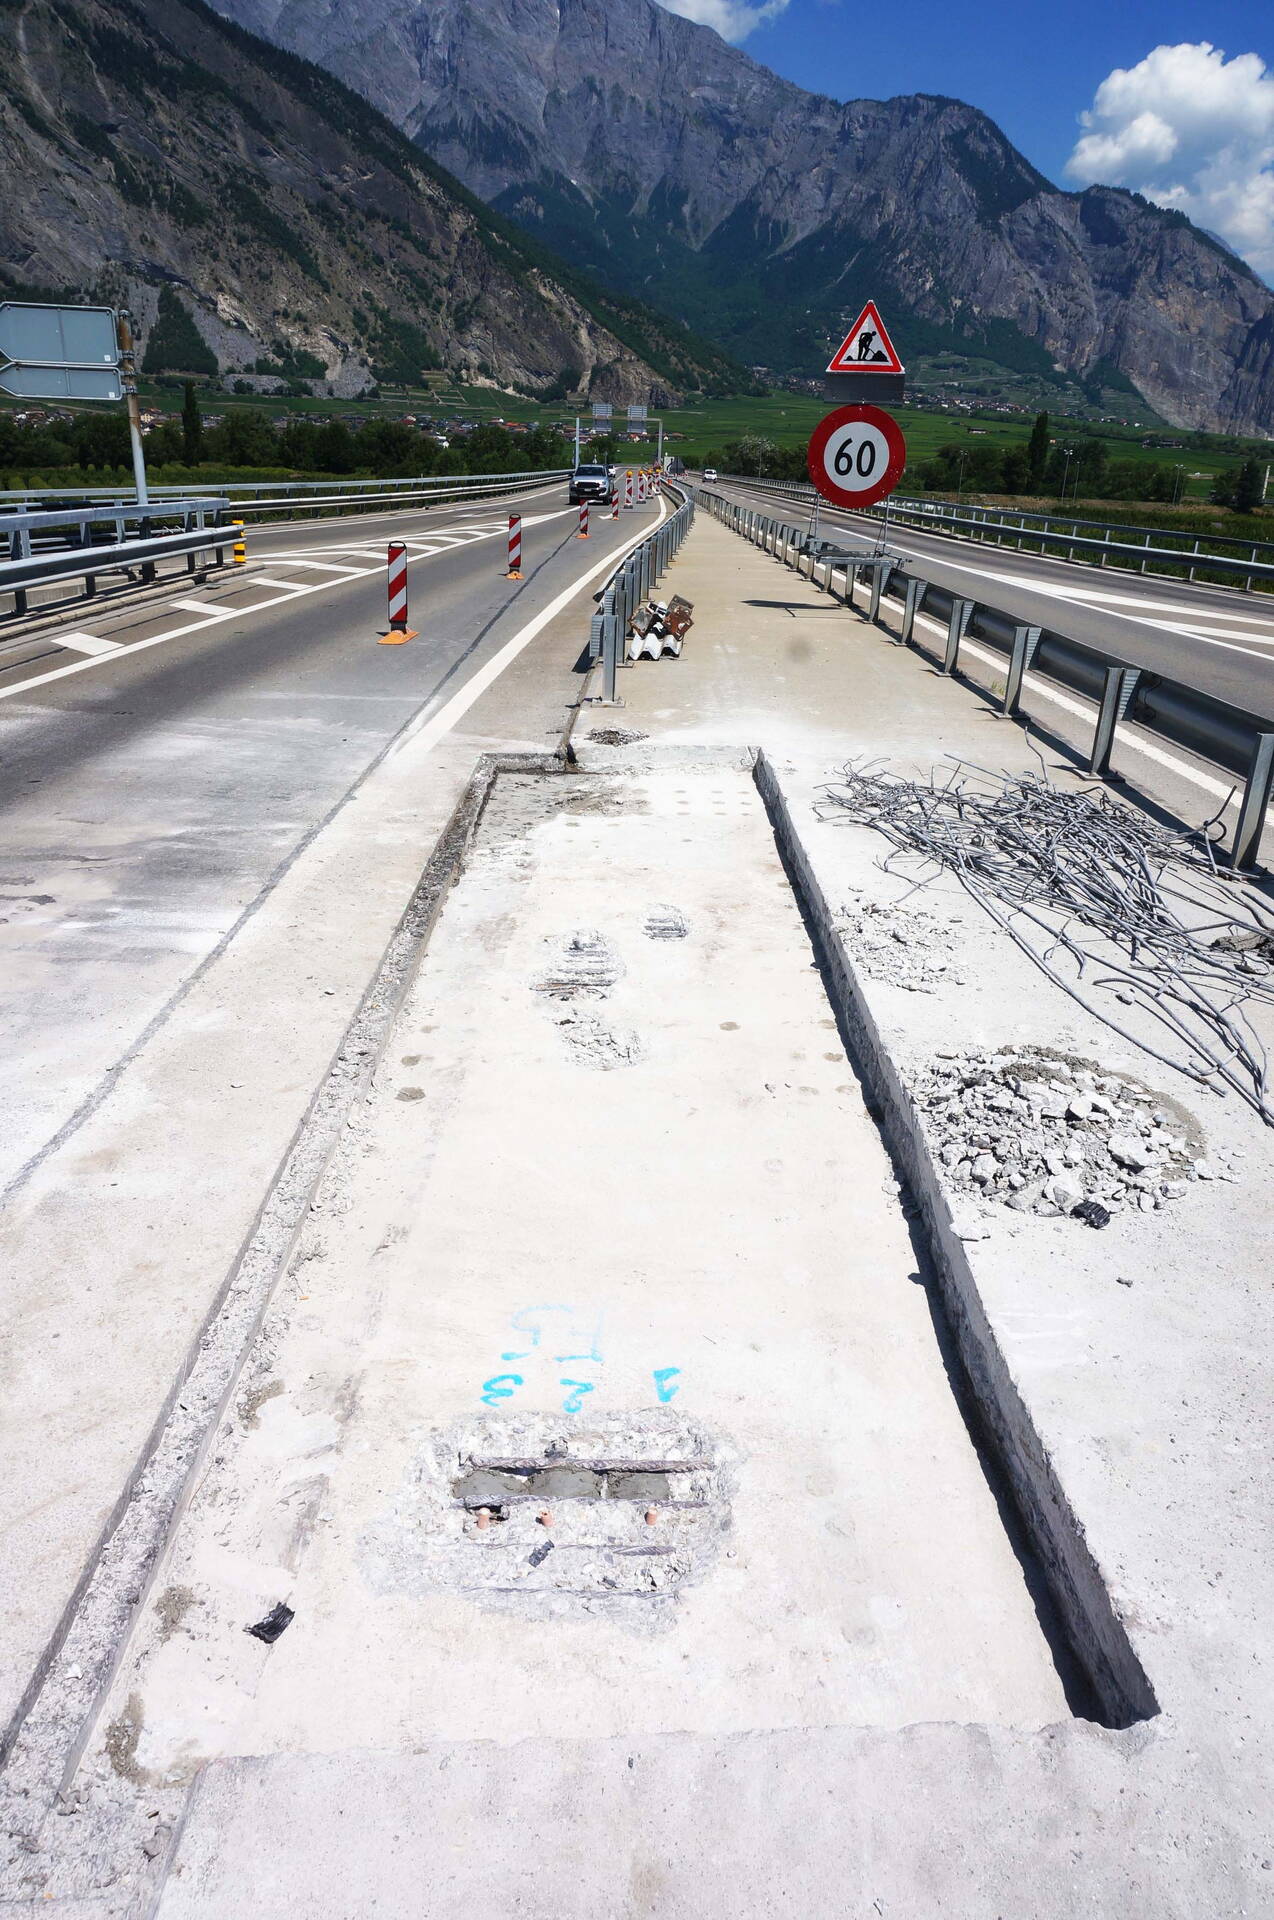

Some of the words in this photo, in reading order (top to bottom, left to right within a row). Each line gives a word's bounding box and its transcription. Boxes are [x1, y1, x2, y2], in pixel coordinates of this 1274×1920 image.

[834, 437, 876, 478] 60
[479, 1373, 525, 1408] 3
[559, 1378, 595, 1413] 2
